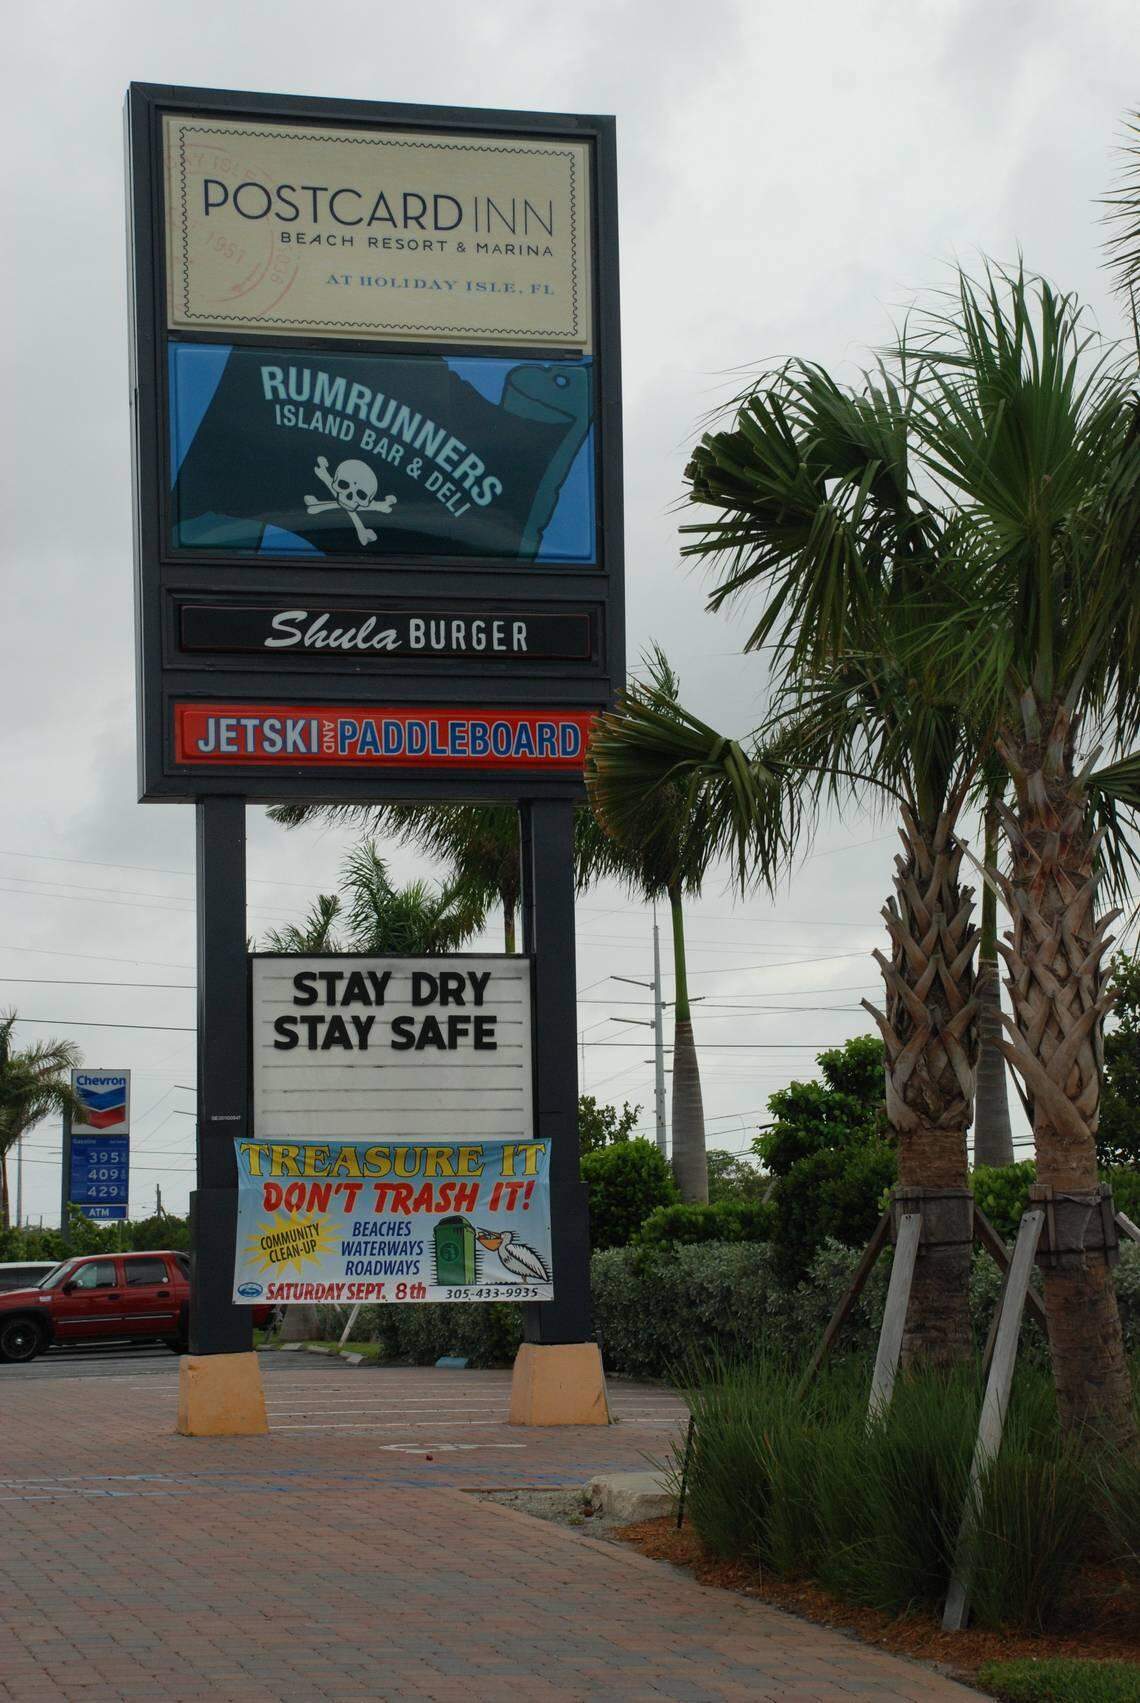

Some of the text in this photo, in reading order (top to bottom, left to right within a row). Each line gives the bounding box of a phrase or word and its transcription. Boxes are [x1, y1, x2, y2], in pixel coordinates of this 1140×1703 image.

[203, 179, 553, 236] POSTCARD INN
[281, 231, 553, 257] BEACH RESORT & MARINA
[326, 274, 353, 286] AT
[359, 275, 457, 291] HOLIDAY
[530, 283, 555, 296] FL
[260, 365, 504, 508] RUMRUNNERS
[274, 404, 473, 518] ISLAND BAR & DELI
[263, 611, 528, 652] Shula BURGER
[197, 717, 583, 758] JETSKI AND PADDLEBOARD
[293, 971, 492, 1007] STAY DRY
[273, 1015, 498, 1050] STAY SAFE
[76, 1075, 127, 1086] Chevron
[88, 1152, 120, 1164] 395
[240, 1143, 546, 1177] TREASURE IT
[87, 1168, 119, 1180] 409
[87, 1185, 118, 1198] 429
[263, 1180, 536, 1215] DON'T TRASH IT!
[88, 1207, 110, 1217] ATM
[260, 1223, 320, 1250] COMMUNITY
[352, 1221, 412, 1237] BEACHES
[269, 1239, 318, 1263] CLEAN-UP
[341, 1241, 424, 1257] WATERWAYS
[345, 1260, 420, 1276] ROADWAYS
[265, 1283, 346, 1301] SATURDAY
[347, 1283, 387, 1300] SEPT.
[446, 1287, 538, 1299] 305-433-9935
